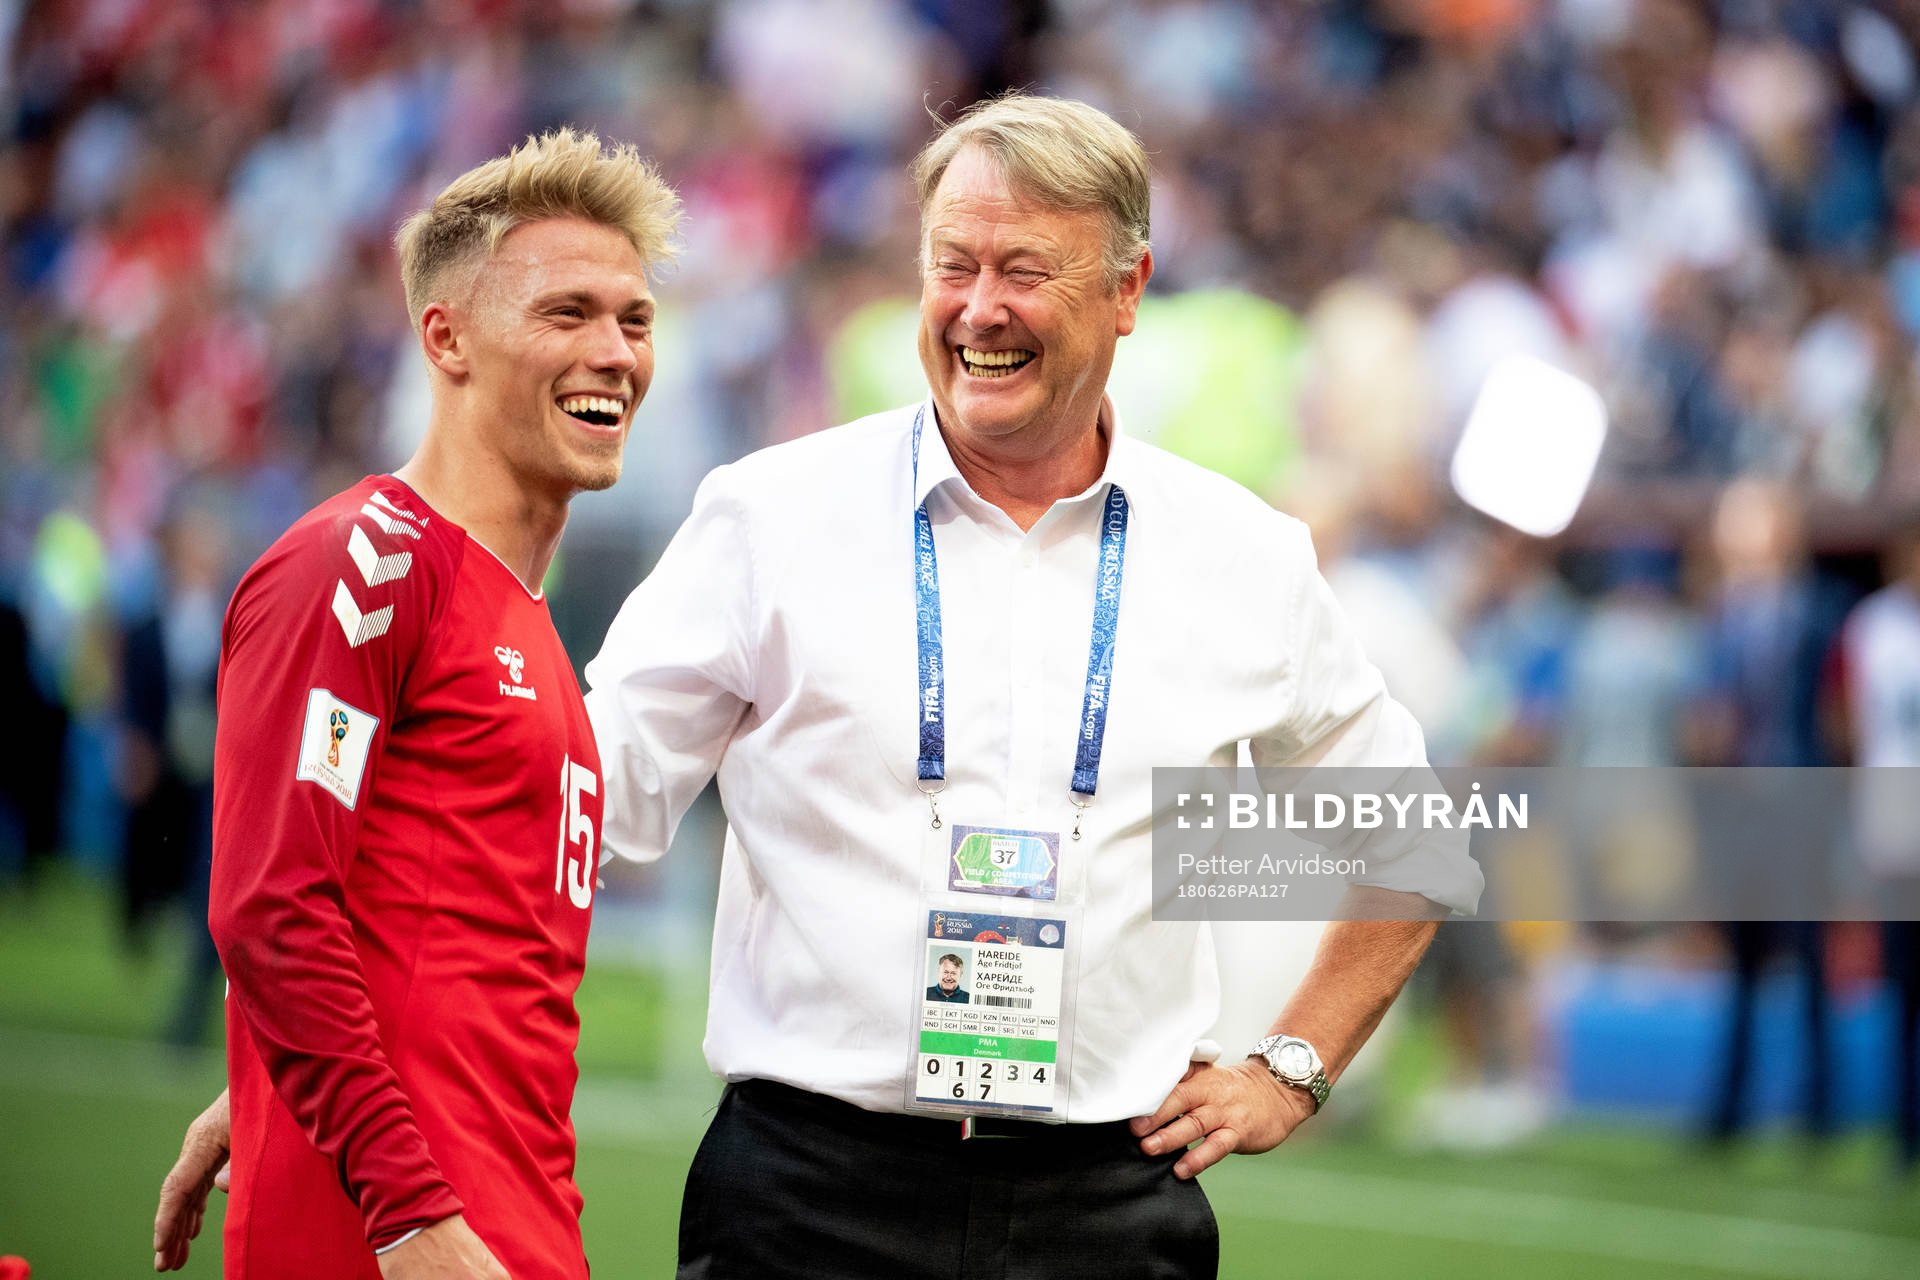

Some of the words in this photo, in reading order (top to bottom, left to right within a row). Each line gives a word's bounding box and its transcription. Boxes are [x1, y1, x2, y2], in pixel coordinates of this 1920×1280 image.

[1108, 511, 1123, 542] CUP
[919, 520, 933, 550] FIFA
[921, 551, 934, 586] 2018
[1101, 544, 1120, 602] RUSSIA
[555, 752, 597, 910] 15
[993, 849, 1016, 865] 37
[946, 921, 973, 929] RUSSIA
[978, 950, 1021, 961] HAREIDE
[994, 960, 1022, 970] Fridtjof
[977, 972, 1023, 984] ХАРЕЙДЕ
[976, 982, 991, 990] Оге
[924, 1021, 939, 1029] RND
[963, 1012, 979, 1020] KGD
[983, 1013, 997, 1021] KZN
[1040, 1018, 1056, 1026] NNO
[978, 1038, 998, 1047] PMA
[973, 1048, 1002, 1057] Denmark
[926, 1058, 940, 1075] 0
[956, 1061, 964, 1077] 1
[980, 1062, 993, 1079] 2
[1007, 1065, 1019, 1081] 3
[1033, 1067, 1046, 1083] 4
[952, 1082, 964, 1098] 6
[979, 1084, 991, 1100] 7
